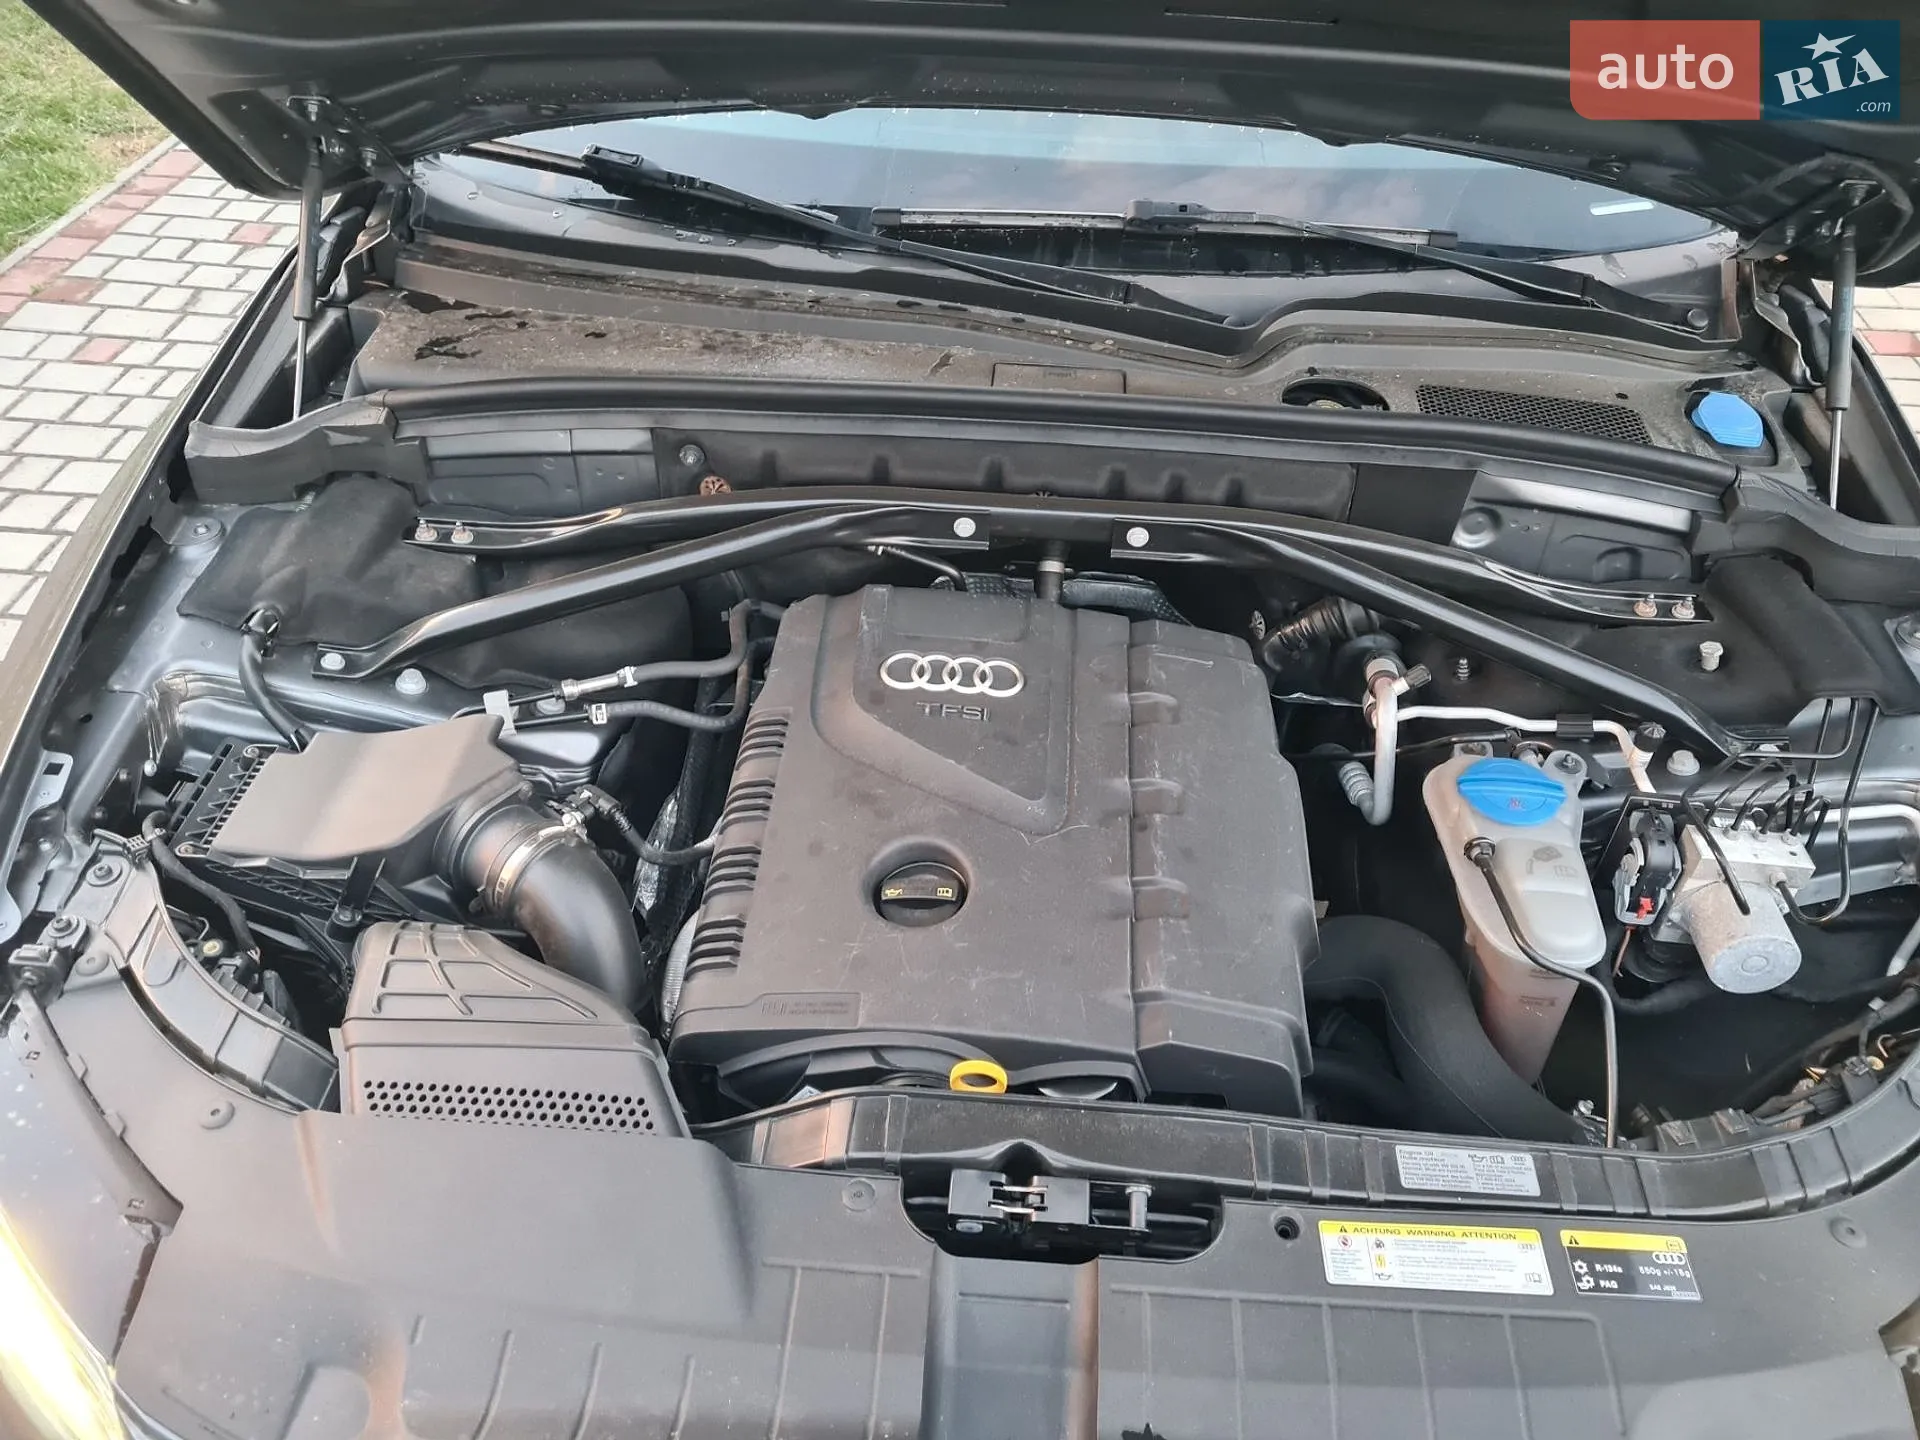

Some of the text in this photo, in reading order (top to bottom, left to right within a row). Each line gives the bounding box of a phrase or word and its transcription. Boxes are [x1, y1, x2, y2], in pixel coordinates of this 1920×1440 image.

[916, 701, 989, 721] TFSI
[1353, 1226, 1517, 1241] ACHTUNG WARNING ATTENTION
[1599, 1279, 1619, 1289] PAG
